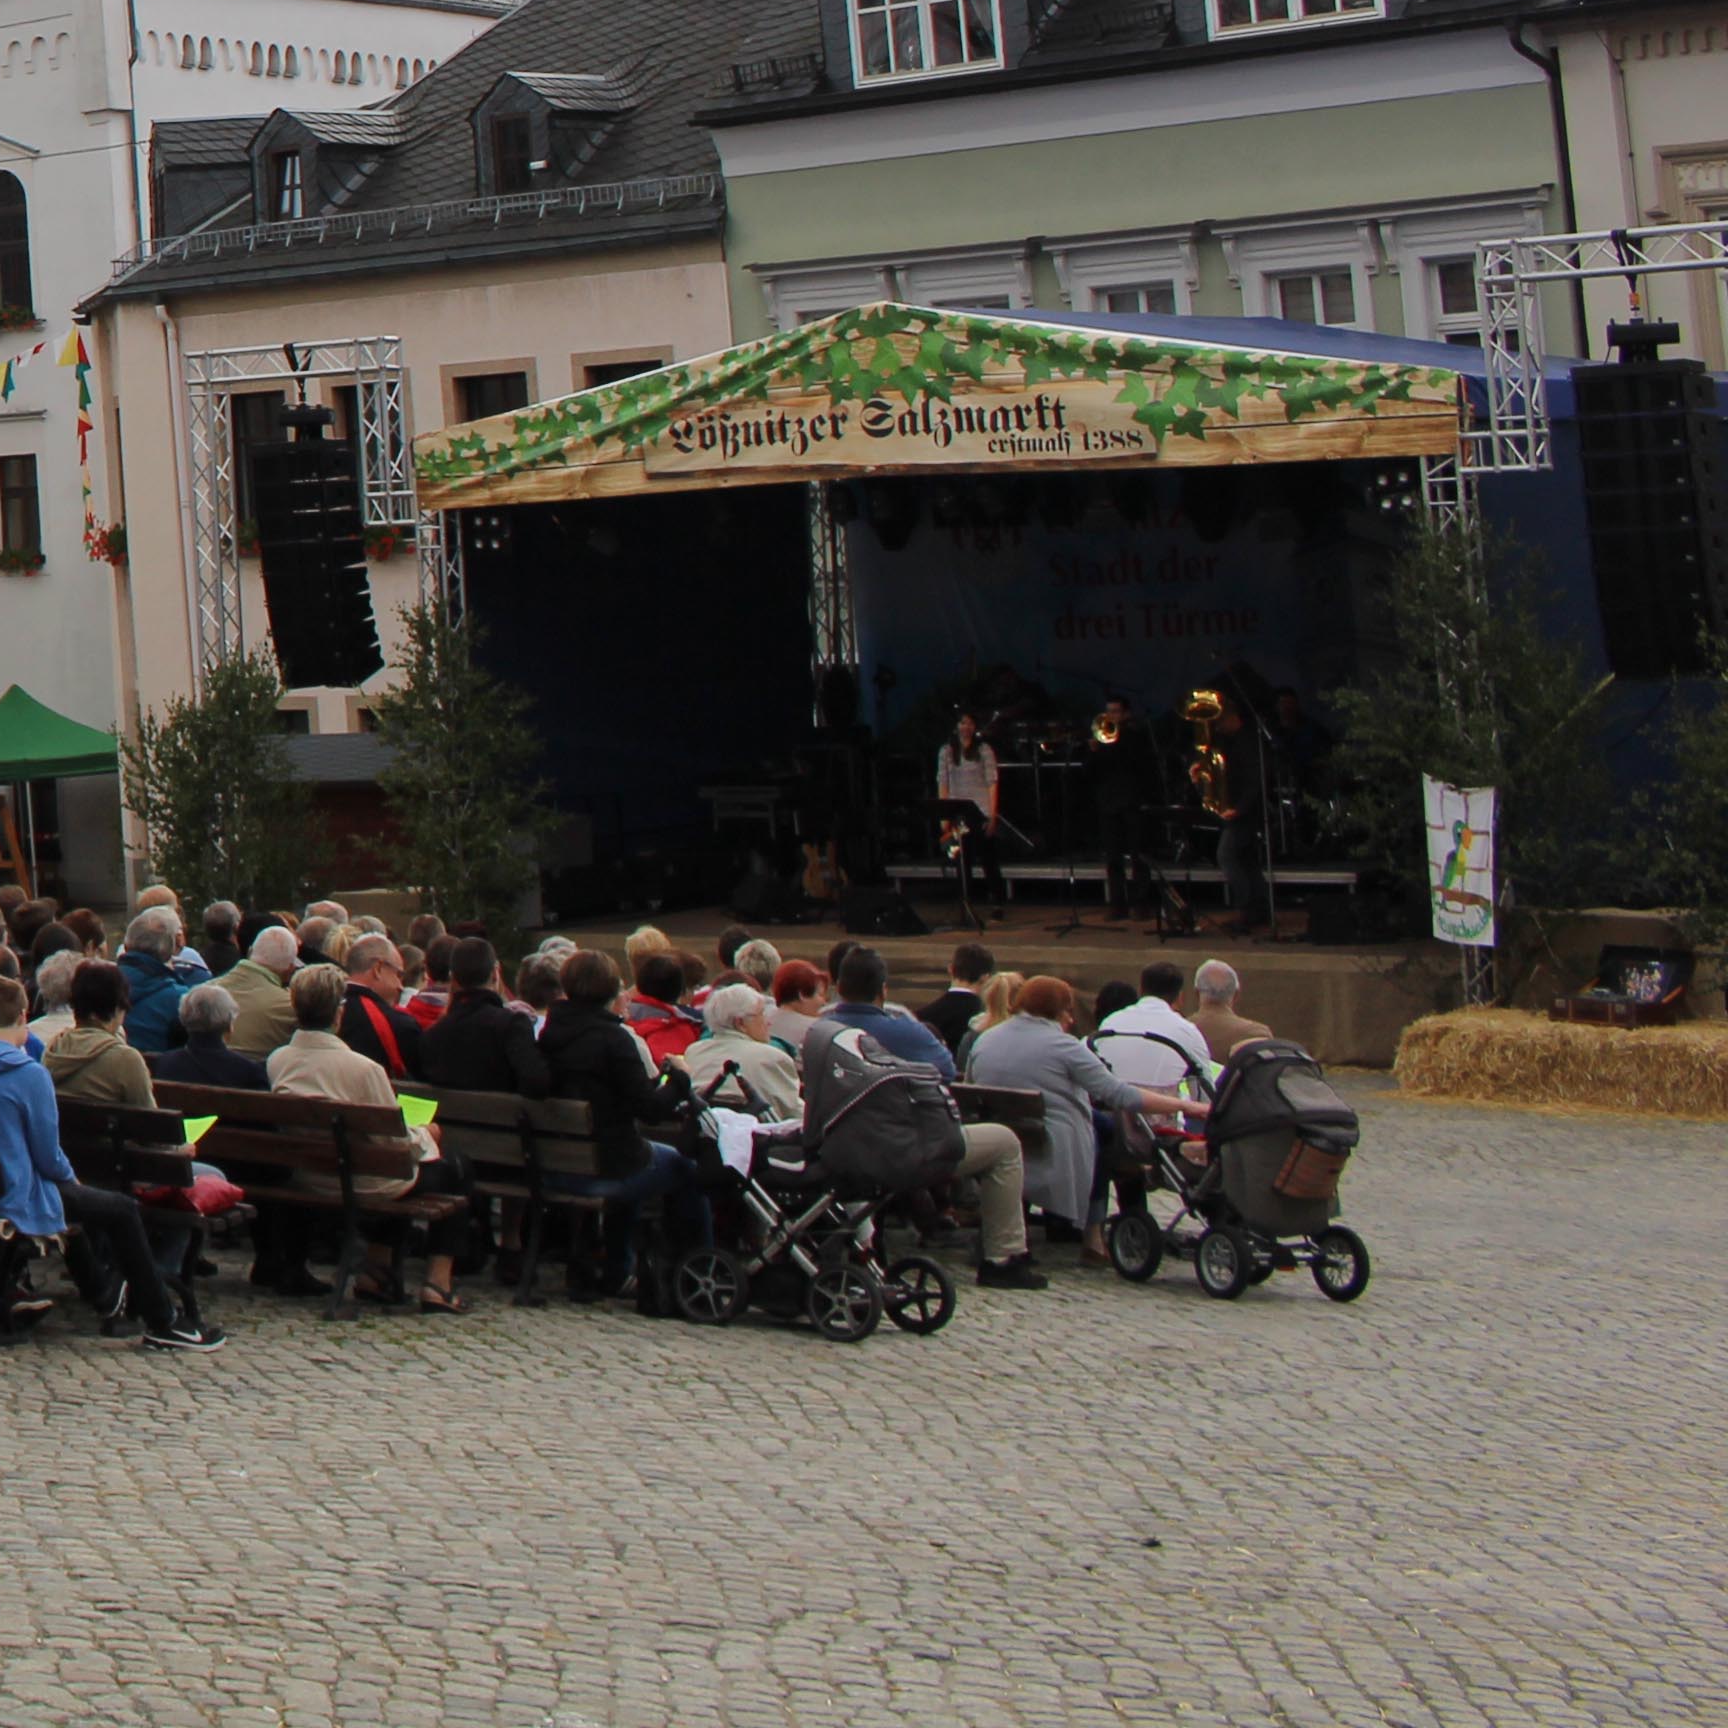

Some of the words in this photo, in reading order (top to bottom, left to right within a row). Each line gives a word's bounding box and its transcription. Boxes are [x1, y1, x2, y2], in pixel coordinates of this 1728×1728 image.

[1082, 428, 1144, 451] 1388
[1156, 547, 1221, 583] der
[1054, 604, 1127, 642] drei
